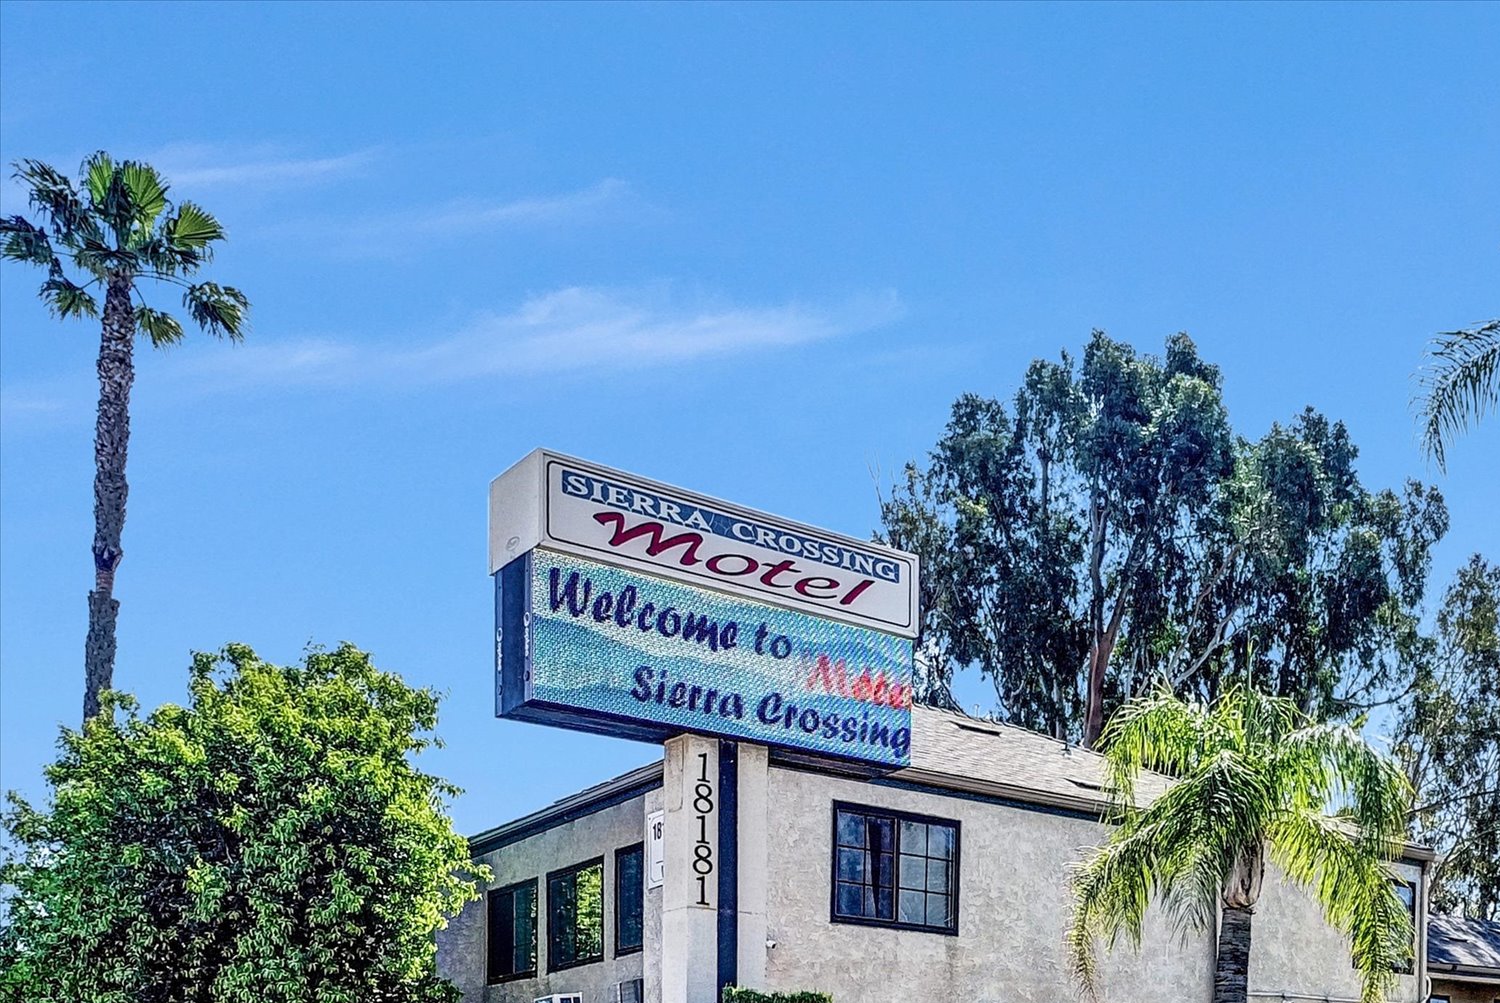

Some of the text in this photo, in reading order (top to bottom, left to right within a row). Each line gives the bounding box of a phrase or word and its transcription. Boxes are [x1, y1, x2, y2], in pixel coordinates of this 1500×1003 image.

[567, 475, 897, 580] SIERRA CROSSING
[592, 511, 875, 605] Motel
[549, 566, 792, 660] Welcome to
[630, 664, 911, 758] Sierra Crossing
[653, 821, 664, 840] 18
[692, 752, 713, 906] 18181
